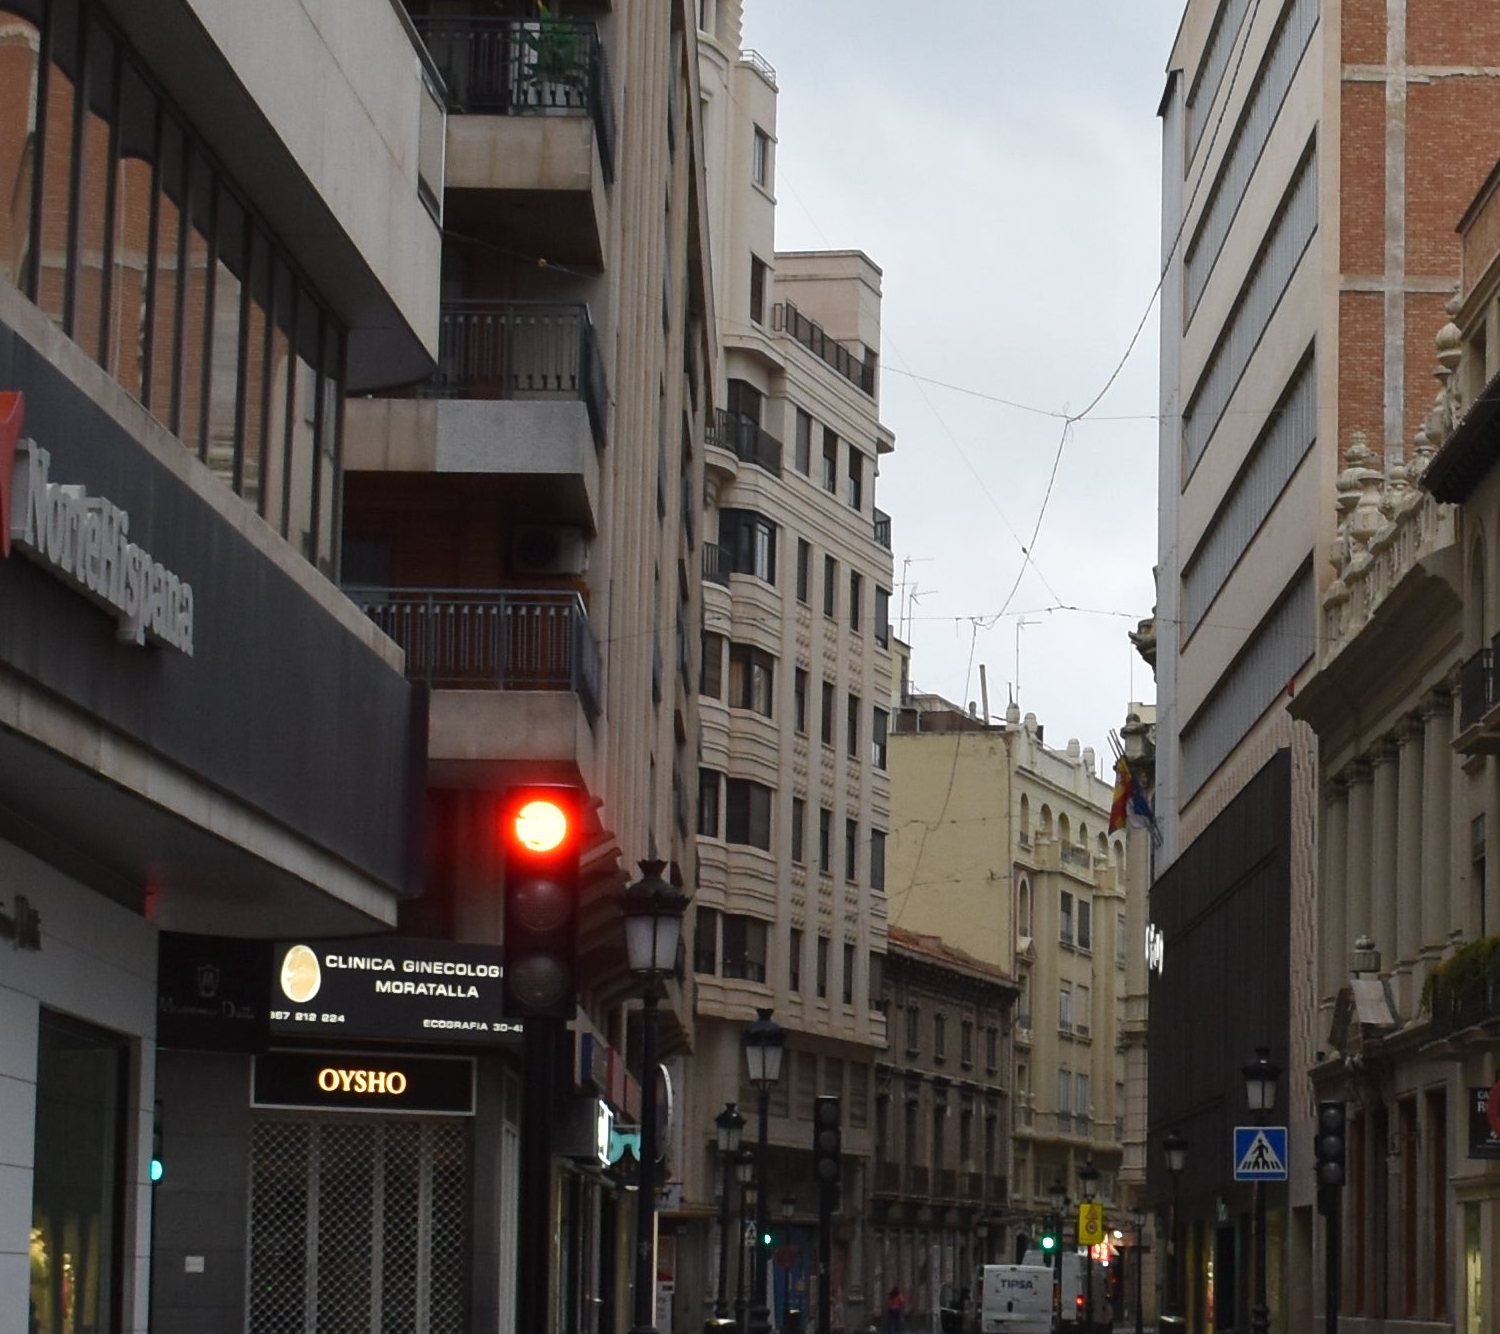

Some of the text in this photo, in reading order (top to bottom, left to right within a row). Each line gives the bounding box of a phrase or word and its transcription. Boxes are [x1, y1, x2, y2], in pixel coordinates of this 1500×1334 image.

[325, 954, 504, 978] CLINICA GINECOLOGI
[375, 979, 480, 999] MORATALLA
[295, 1012, 317, 1022] 212
[321, 1013, 345, 1023] 224
[423, 1019, 489, 1031] ECOGRAFIA
[318, 1068, 407, 1095] OYSHO
[1000, 1279, 1034, 1290] TIPSA
